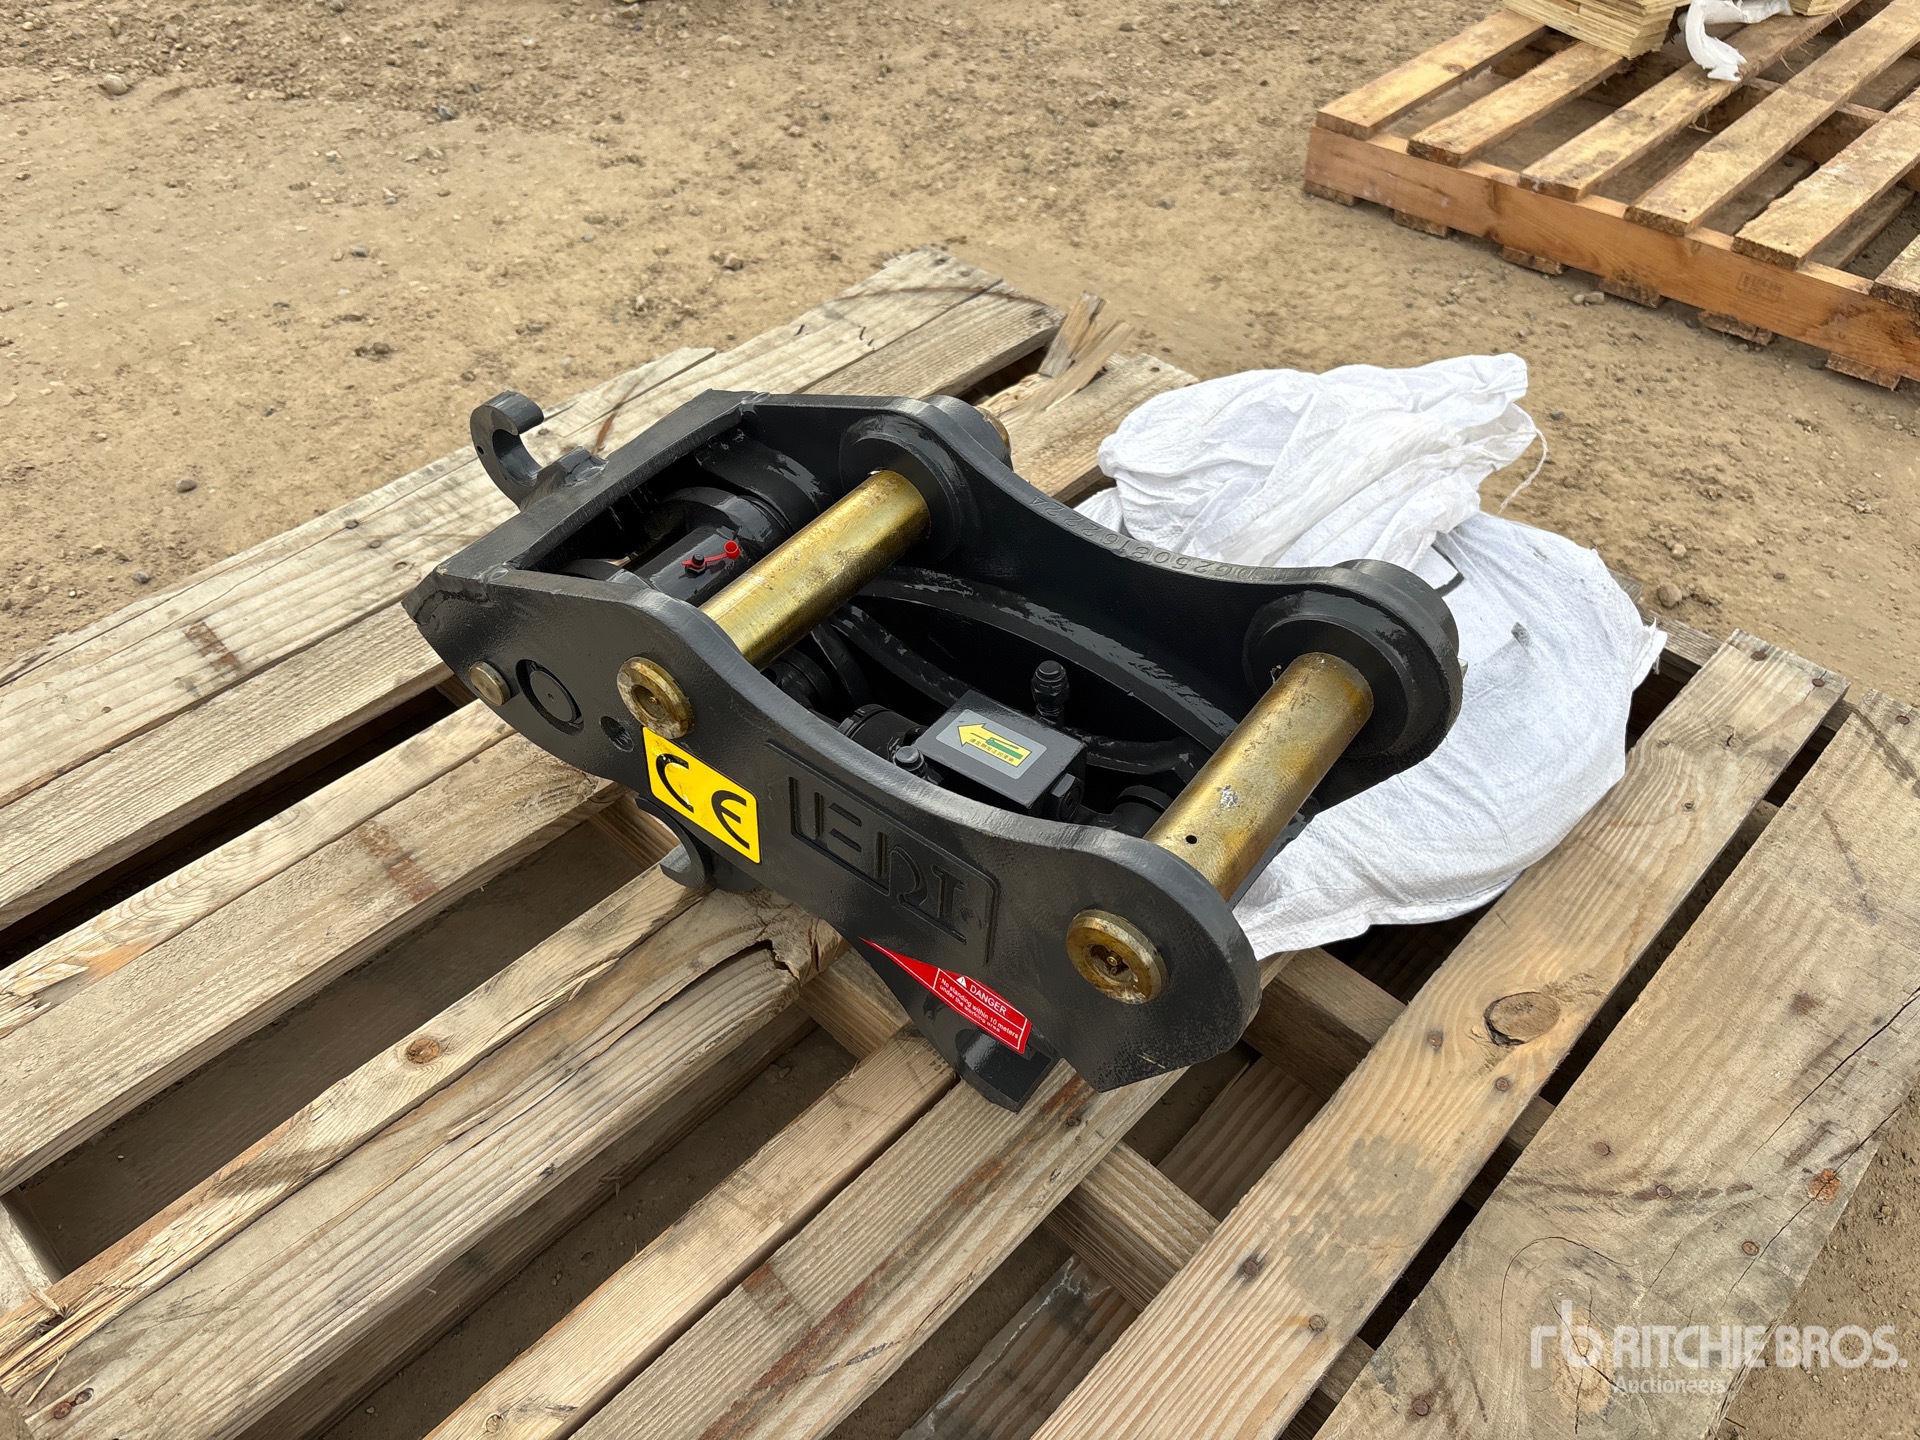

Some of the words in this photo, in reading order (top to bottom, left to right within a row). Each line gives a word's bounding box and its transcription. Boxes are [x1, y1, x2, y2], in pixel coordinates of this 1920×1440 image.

[656, 754, 750, 850] CE
[940, 986, 955, 999] under
[955, 997, 964, 1008] the
[965, 1007, 987, 1025] working
[988, 1022, 1000, 1033] area
[941, 978, 950, 988] No
[949, 985, 972, 1008] standing
[971, 1005, 989, 1020] within
[990, 1016, 998, 1026] 10
[998, 1022, 1019, 1039] meters
[970, 984, 1007, 1015] DANGER
